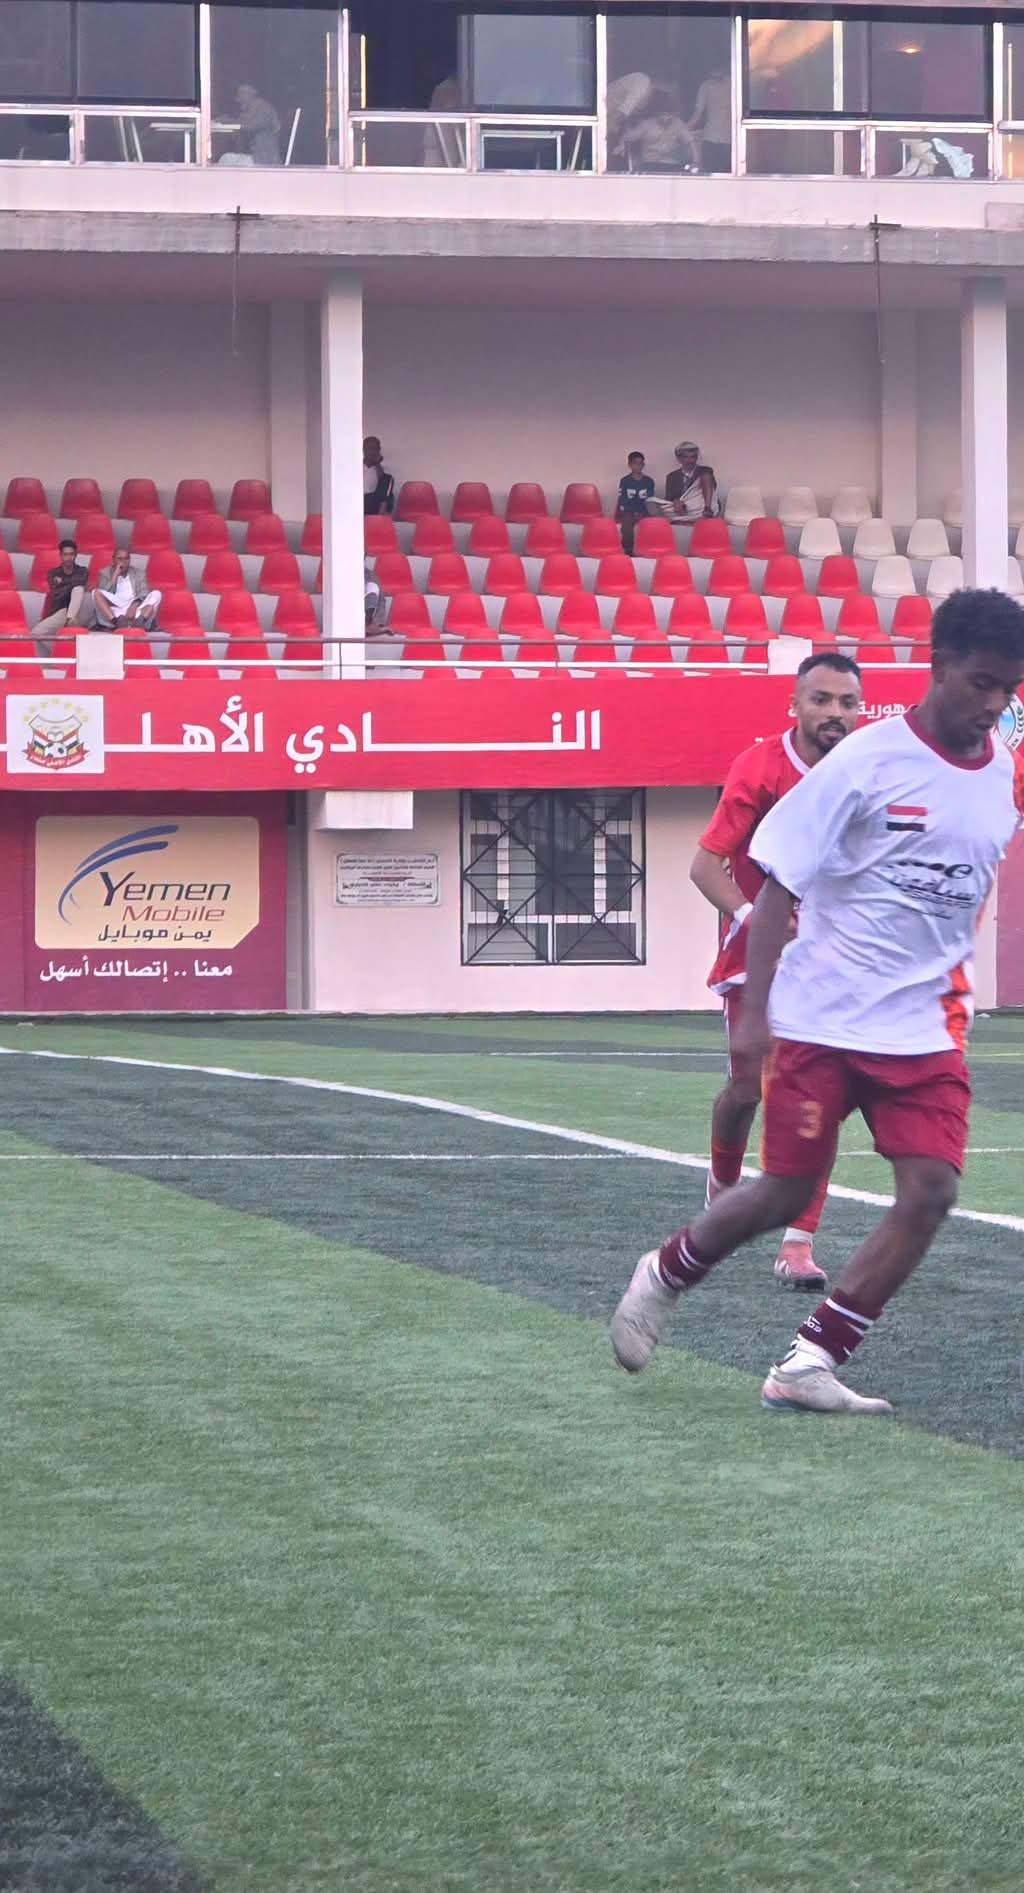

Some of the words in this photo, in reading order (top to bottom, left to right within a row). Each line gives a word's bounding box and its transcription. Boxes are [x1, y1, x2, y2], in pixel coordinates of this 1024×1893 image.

[857, 700, 906, 719] هورية
[103, 695, 264, 752] الأهل
[286, 709, 600, 774] النادي
[99, 871, 231, 907] Yemen
[121, 905, 225, 922] Mobile
[98, 924, 168, 942] موبايل
[173, 925, 212, 942] يمن
[39, 955, 89, 982] أسهل
[93, 959, 169, 983] إتصالك
[194, 959, 233, 977] معنا
